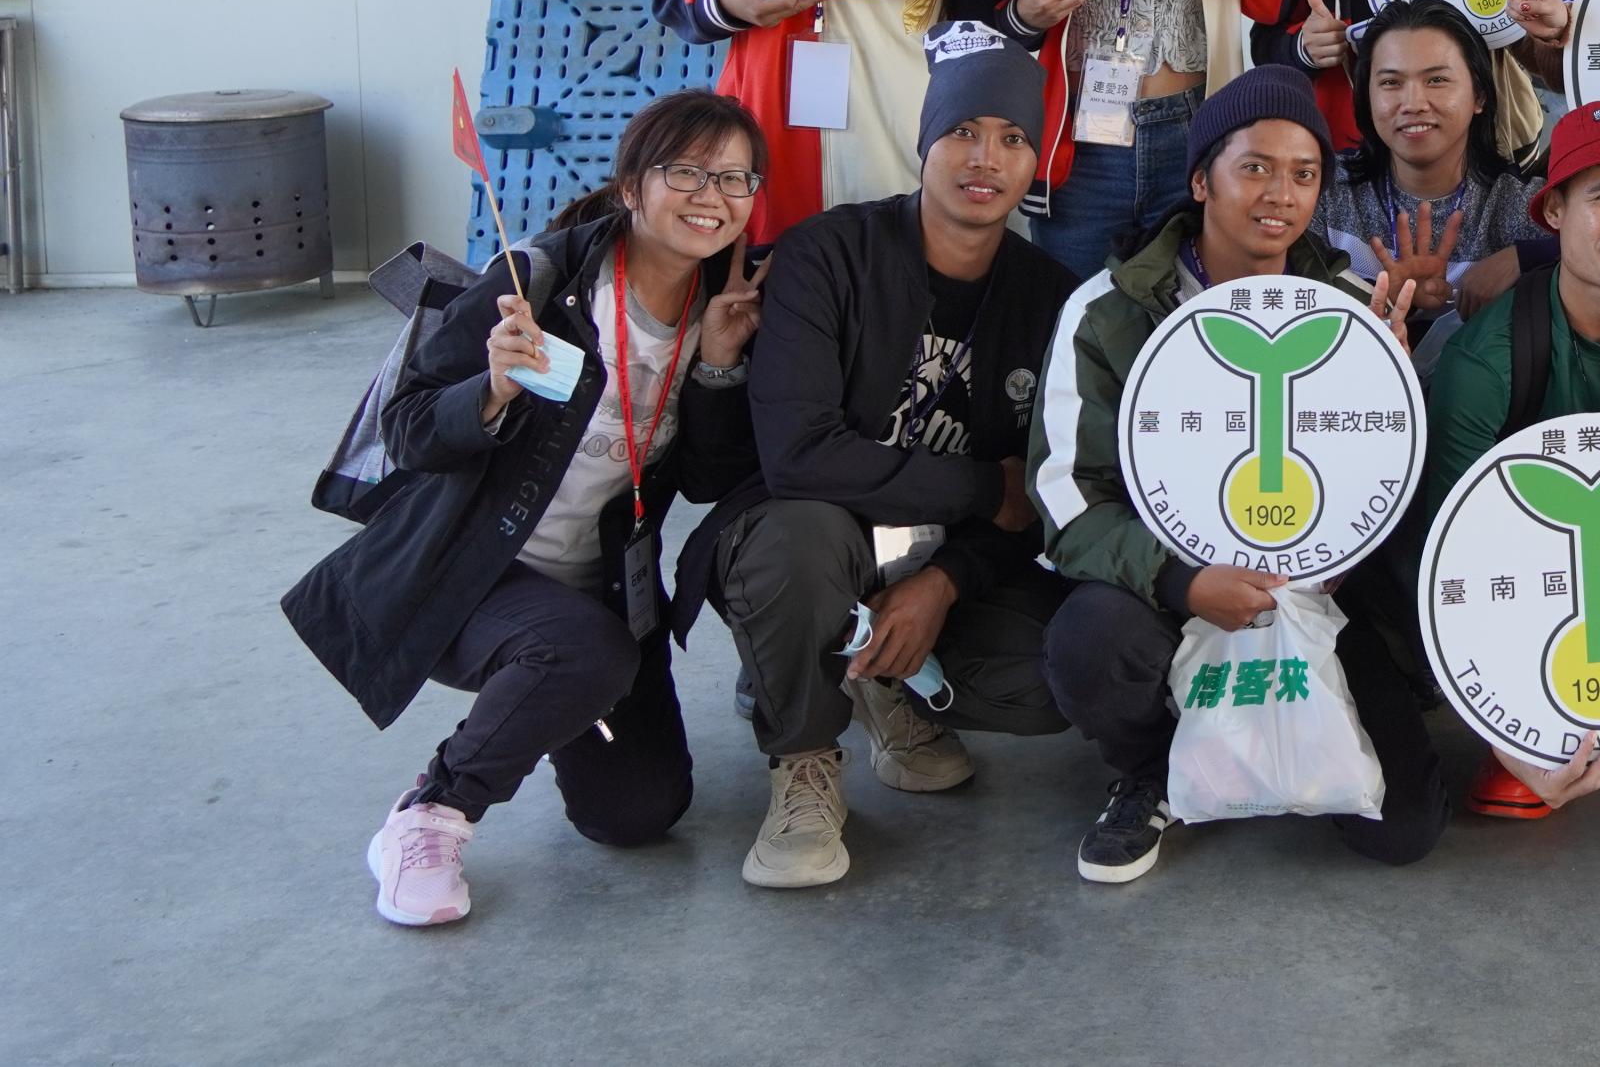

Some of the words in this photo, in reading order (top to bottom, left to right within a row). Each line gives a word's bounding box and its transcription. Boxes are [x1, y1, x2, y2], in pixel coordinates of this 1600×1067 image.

[1229, 287, 1317, 311] 農業部
[1138, 410, 1247, 433] 臺南區
[1296, 410, 1407, 433] 農業改良場
[1147, 480, 1216, 560] Tainan
[1350, 479, 1401, 538] MOA
[1244, 505, 1296, 526] 1902
[1440, 570, 1568, 606] 臺南區
[1456, 659, 1541, 747] Tainan
